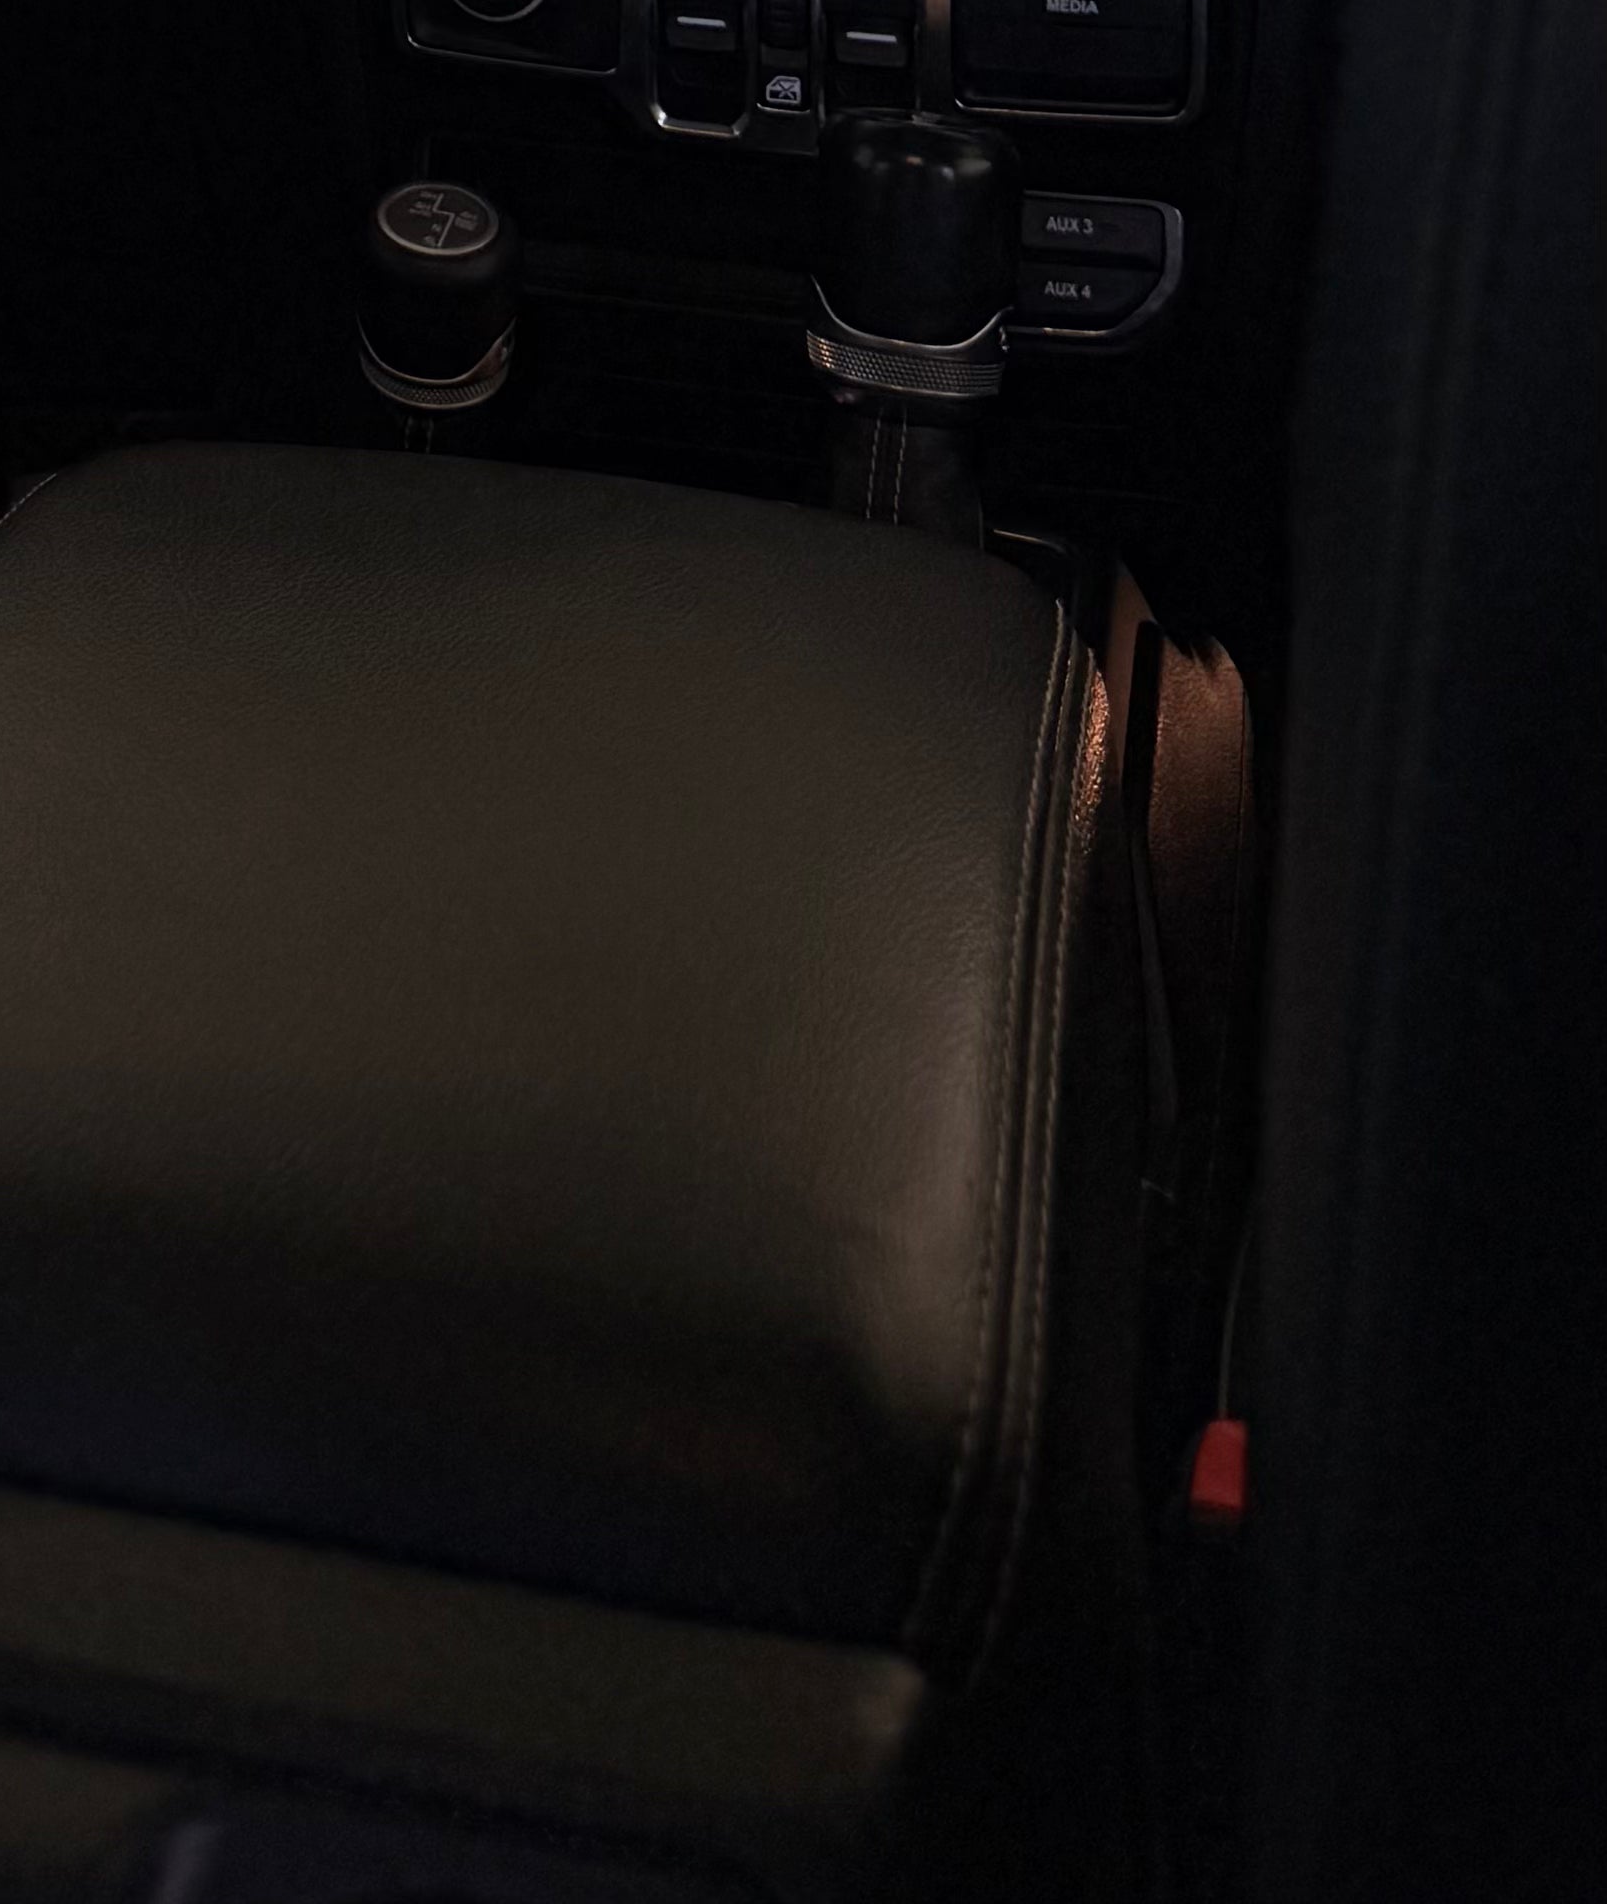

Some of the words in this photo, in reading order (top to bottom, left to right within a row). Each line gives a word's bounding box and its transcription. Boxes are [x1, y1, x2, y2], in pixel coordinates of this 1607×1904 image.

[1046, 215, 1081, 233] AUX
[1082, 217, 1094, 234] 3
[1044, 279, 1080, 299] AUX
[1081, 283, 1092, 300] 4
